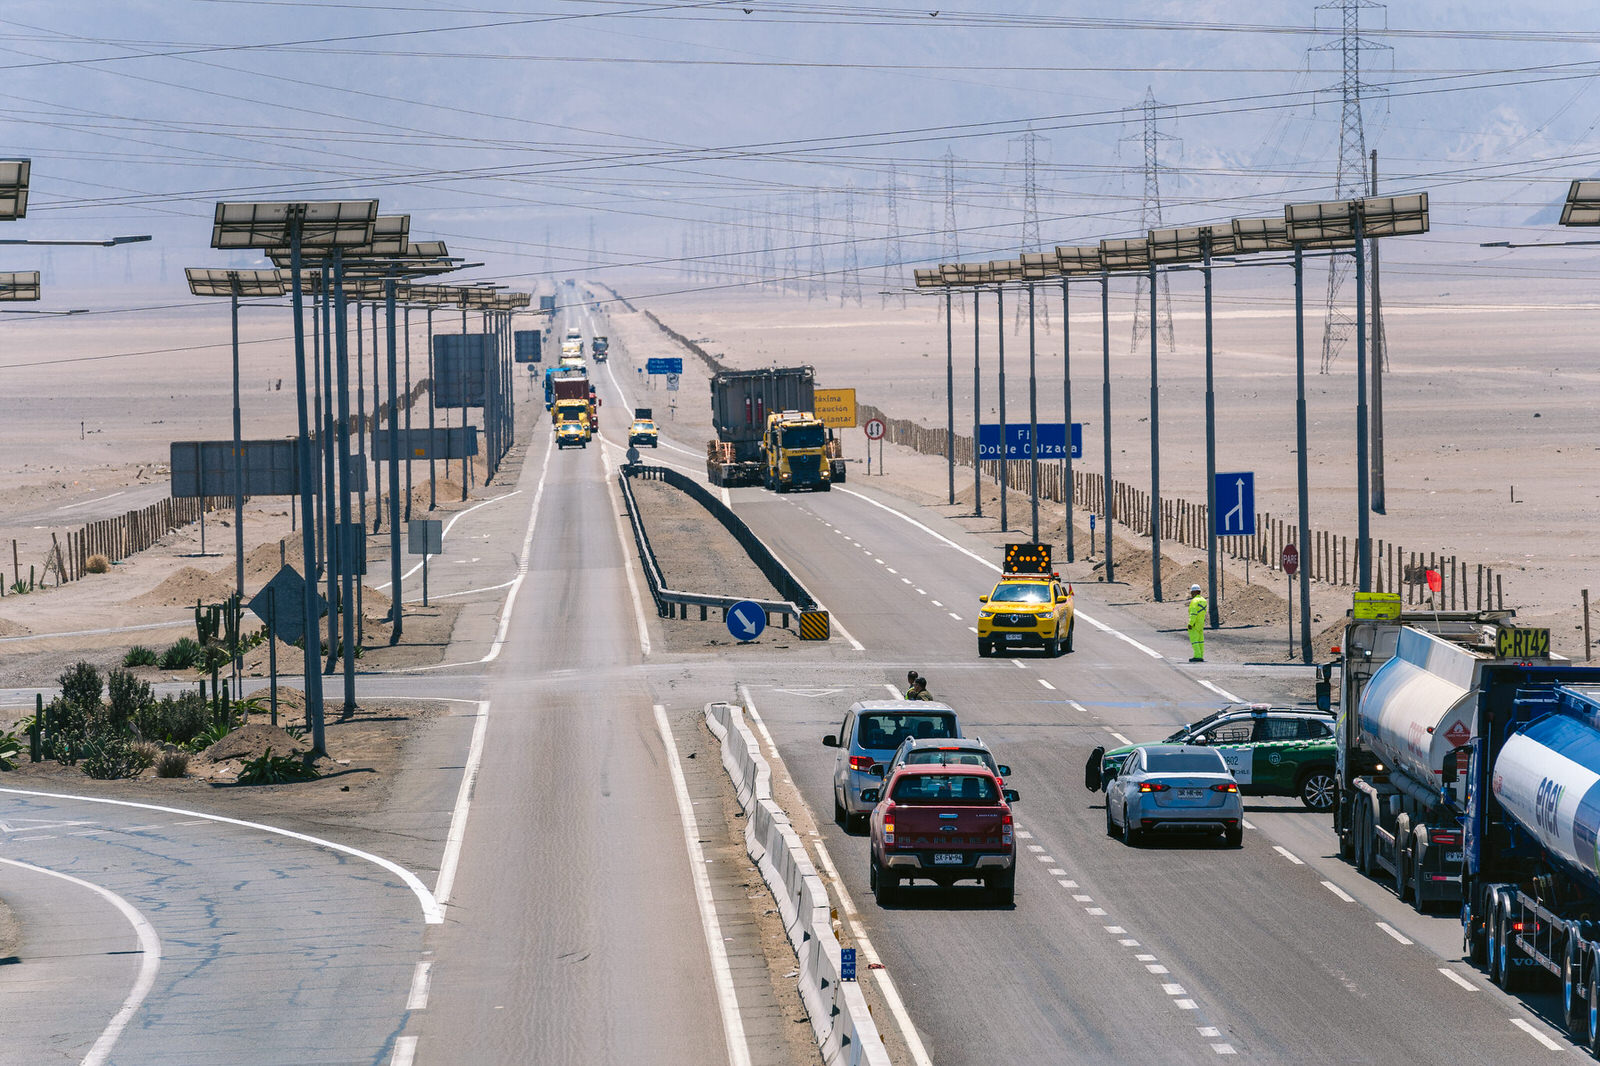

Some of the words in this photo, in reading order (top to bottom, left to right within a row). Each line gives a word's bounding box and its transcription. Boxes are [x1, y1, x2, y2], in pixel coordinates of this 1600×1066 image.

[1017, 429, 1037, 440] Fi
[1283, 554, 1297, 564] PARE
[1498, 629, 1549, 657] C-RT42
